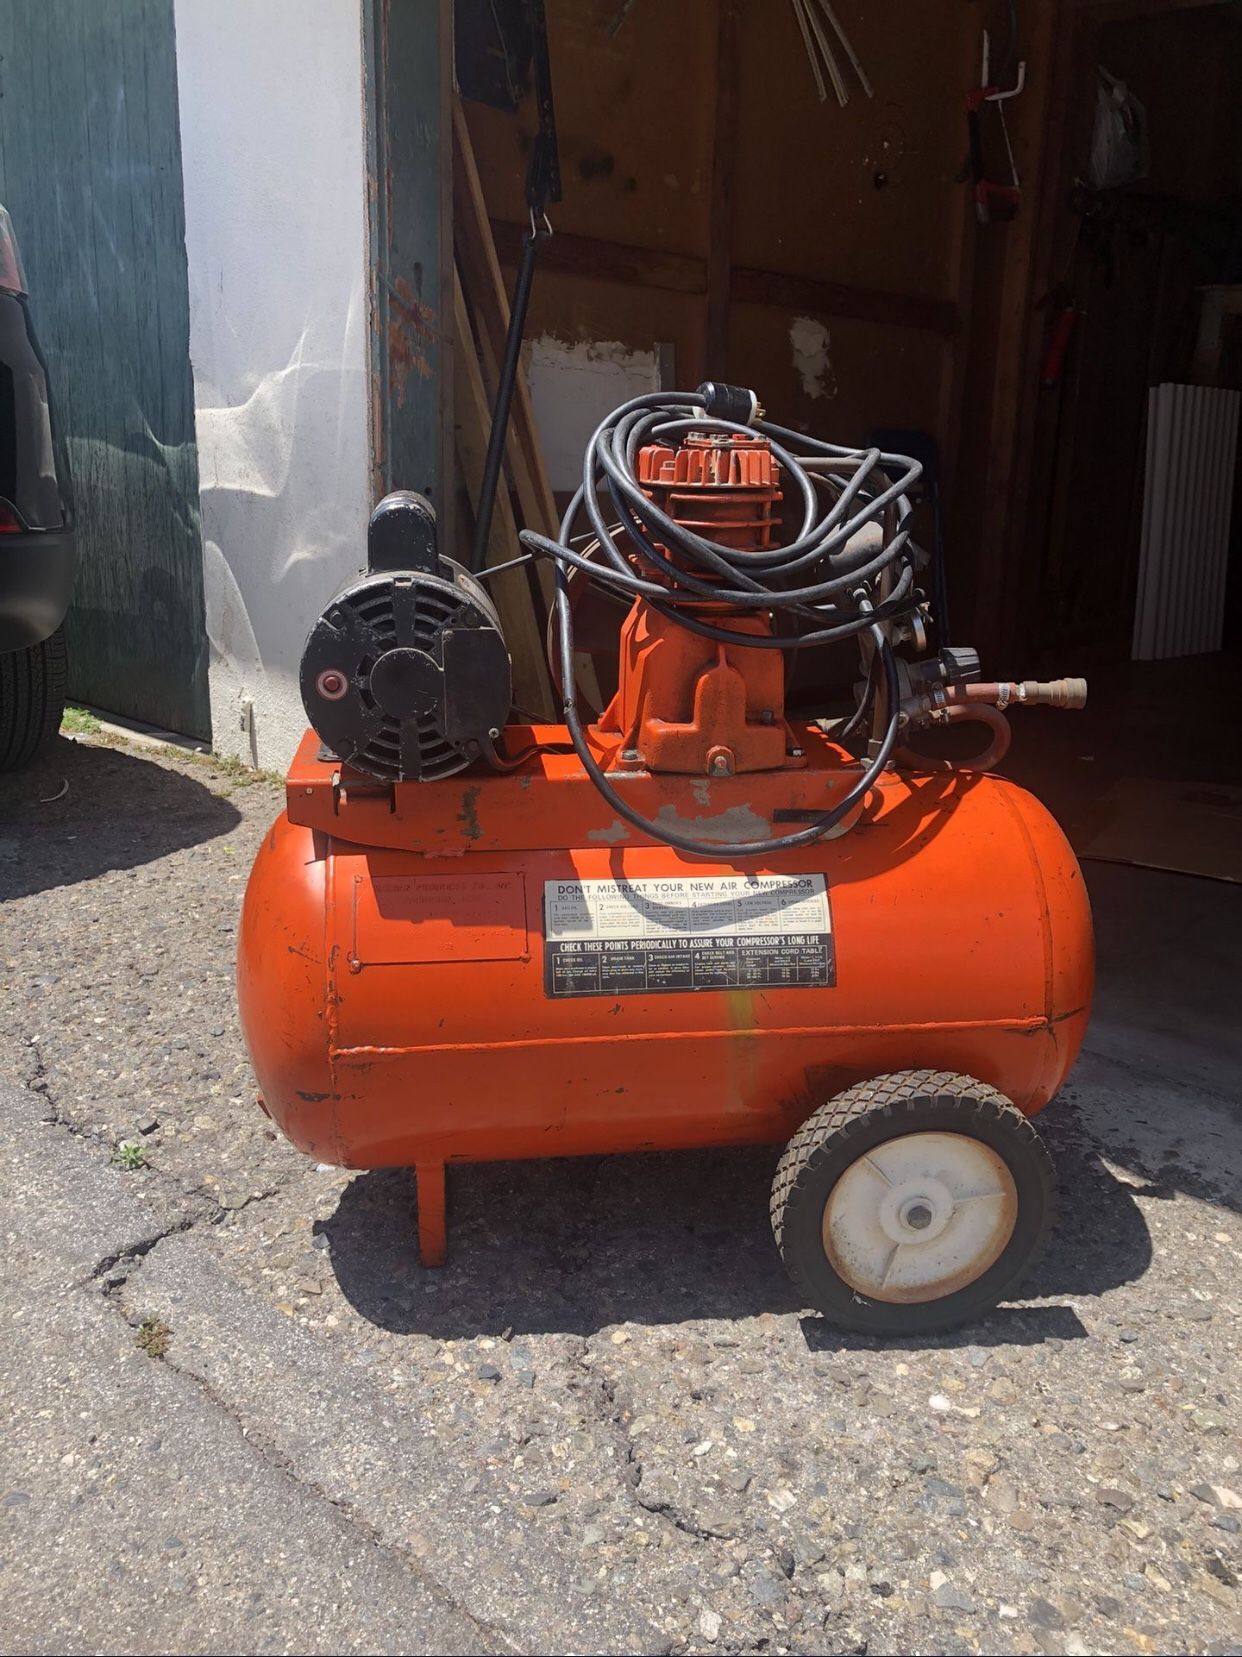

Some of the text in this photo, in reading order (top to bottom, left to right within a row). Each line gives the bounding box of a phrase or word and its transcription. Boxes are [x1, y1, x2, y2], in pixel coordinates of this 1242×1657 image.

[557, 879, 813, 894] DON'T MISTREAT YOUR NEW AIR COMPRESSOR
[644, 902, 650, 910] 3
[560, 935, 820, 952] CHECK THESE POINTS PERIODICALLY TO ASSURE YOUR COMPRESSOR'S LONG LIFE
[601, 955, 608, 963] 2
[648, 953, 654, 962] 3
[694, 952, 700, 960] 4
[556, 957, 560, 965] 1
